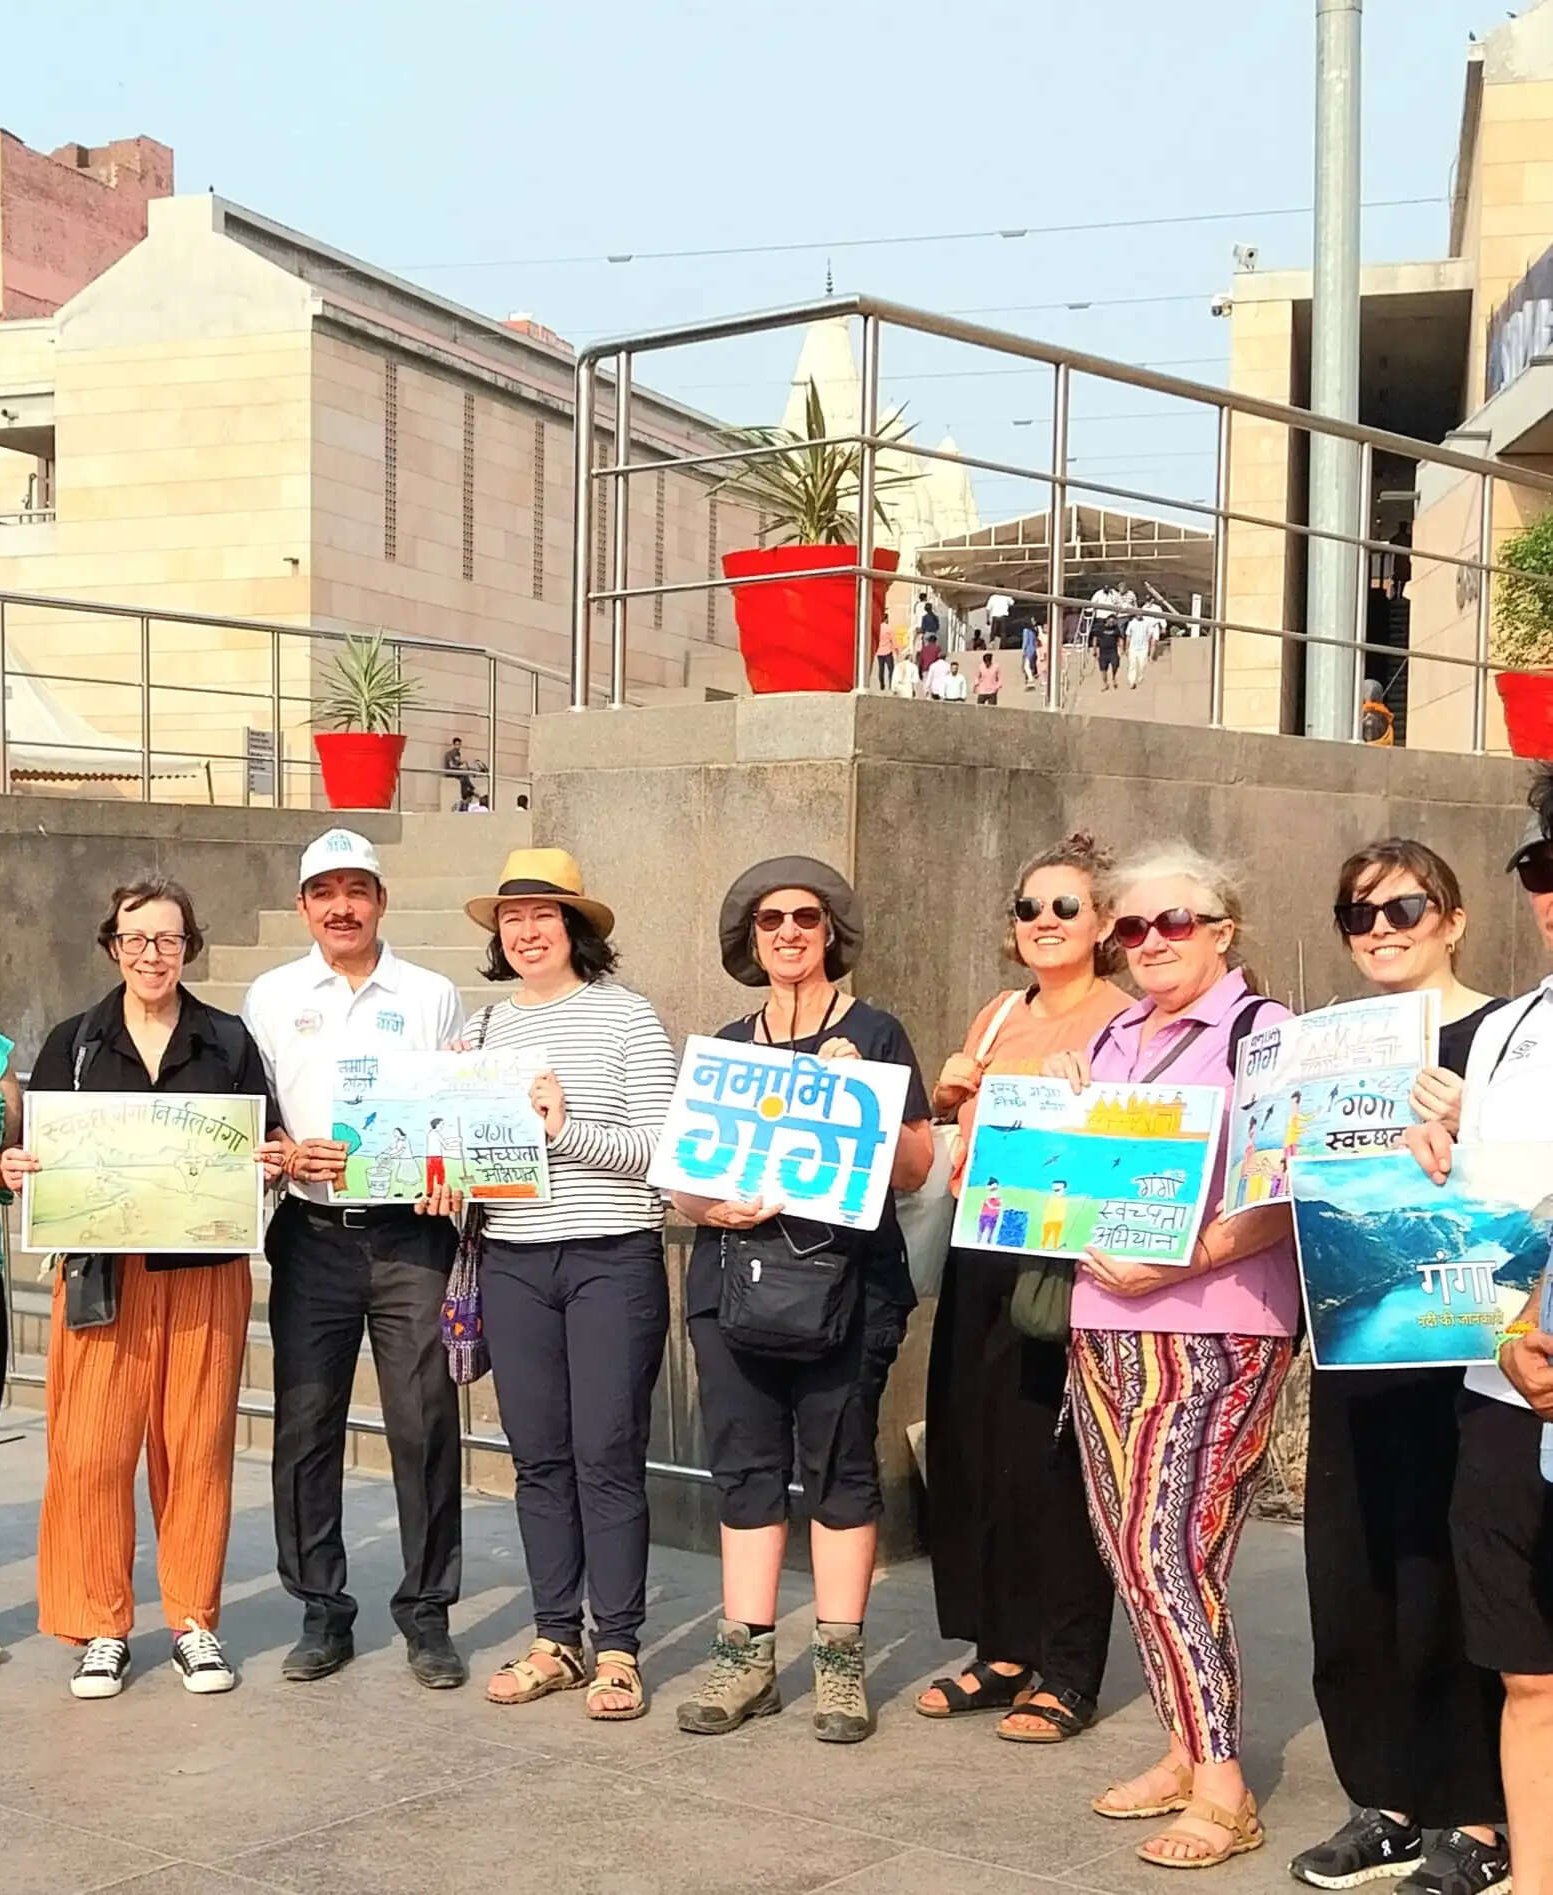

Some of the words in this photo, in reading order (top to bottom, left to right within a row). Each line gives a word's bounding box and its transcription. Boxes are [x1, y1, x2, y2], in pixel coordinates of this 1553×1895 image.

[693, 1053, 841, 1119] नमामि
[150, 1099, 208, 1137] निर्मल
[205, 1116, 250, 1153] गंगा
[672, 1077, 887, 1224] गंगे
[1135, 1172, 1185, 1198] गंगा
[1415, 1249, 1497, 1305] गंगा
